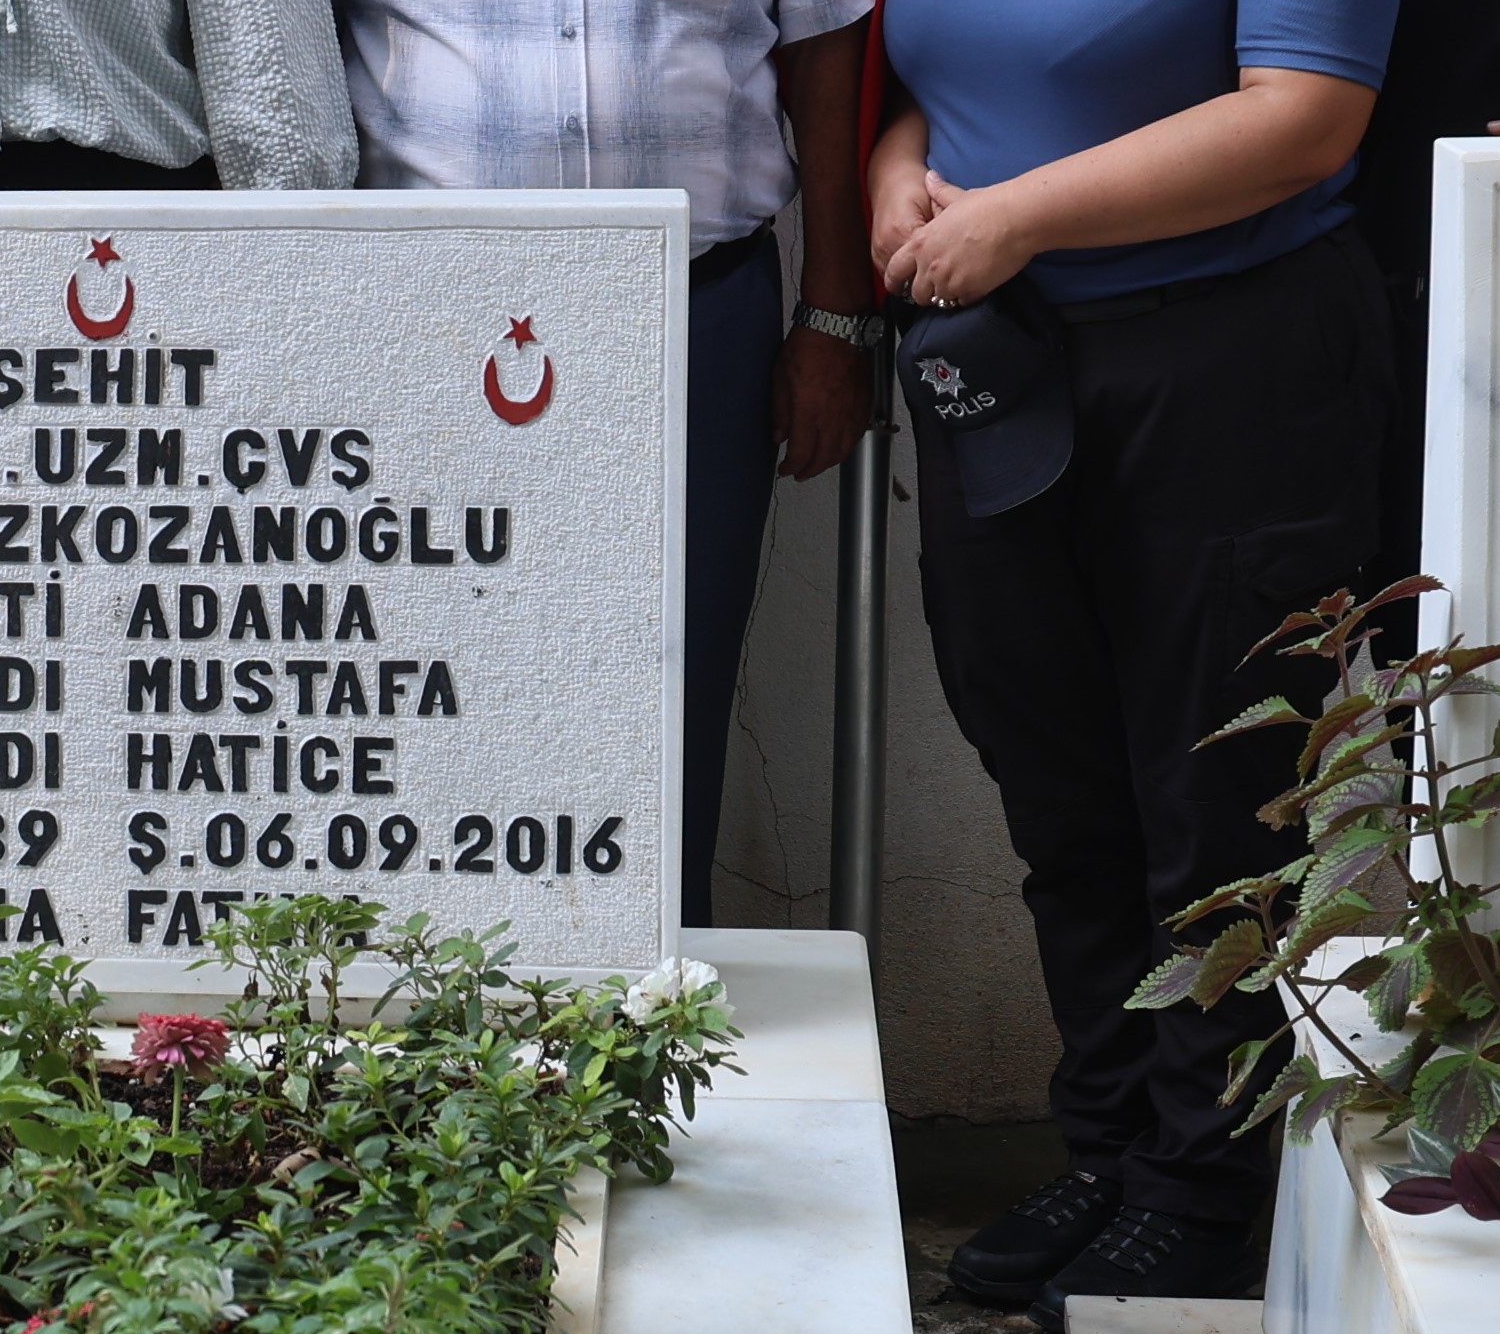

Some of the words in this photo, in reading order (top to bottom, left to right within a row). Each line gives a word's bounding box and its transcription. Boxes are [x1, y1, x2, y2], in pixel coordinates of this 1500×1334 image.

[126, 583, 378, 641] ADANA
[126, 656, 459, 716] MUSTAFA
[126, 721, 396, 795] HATİCE
